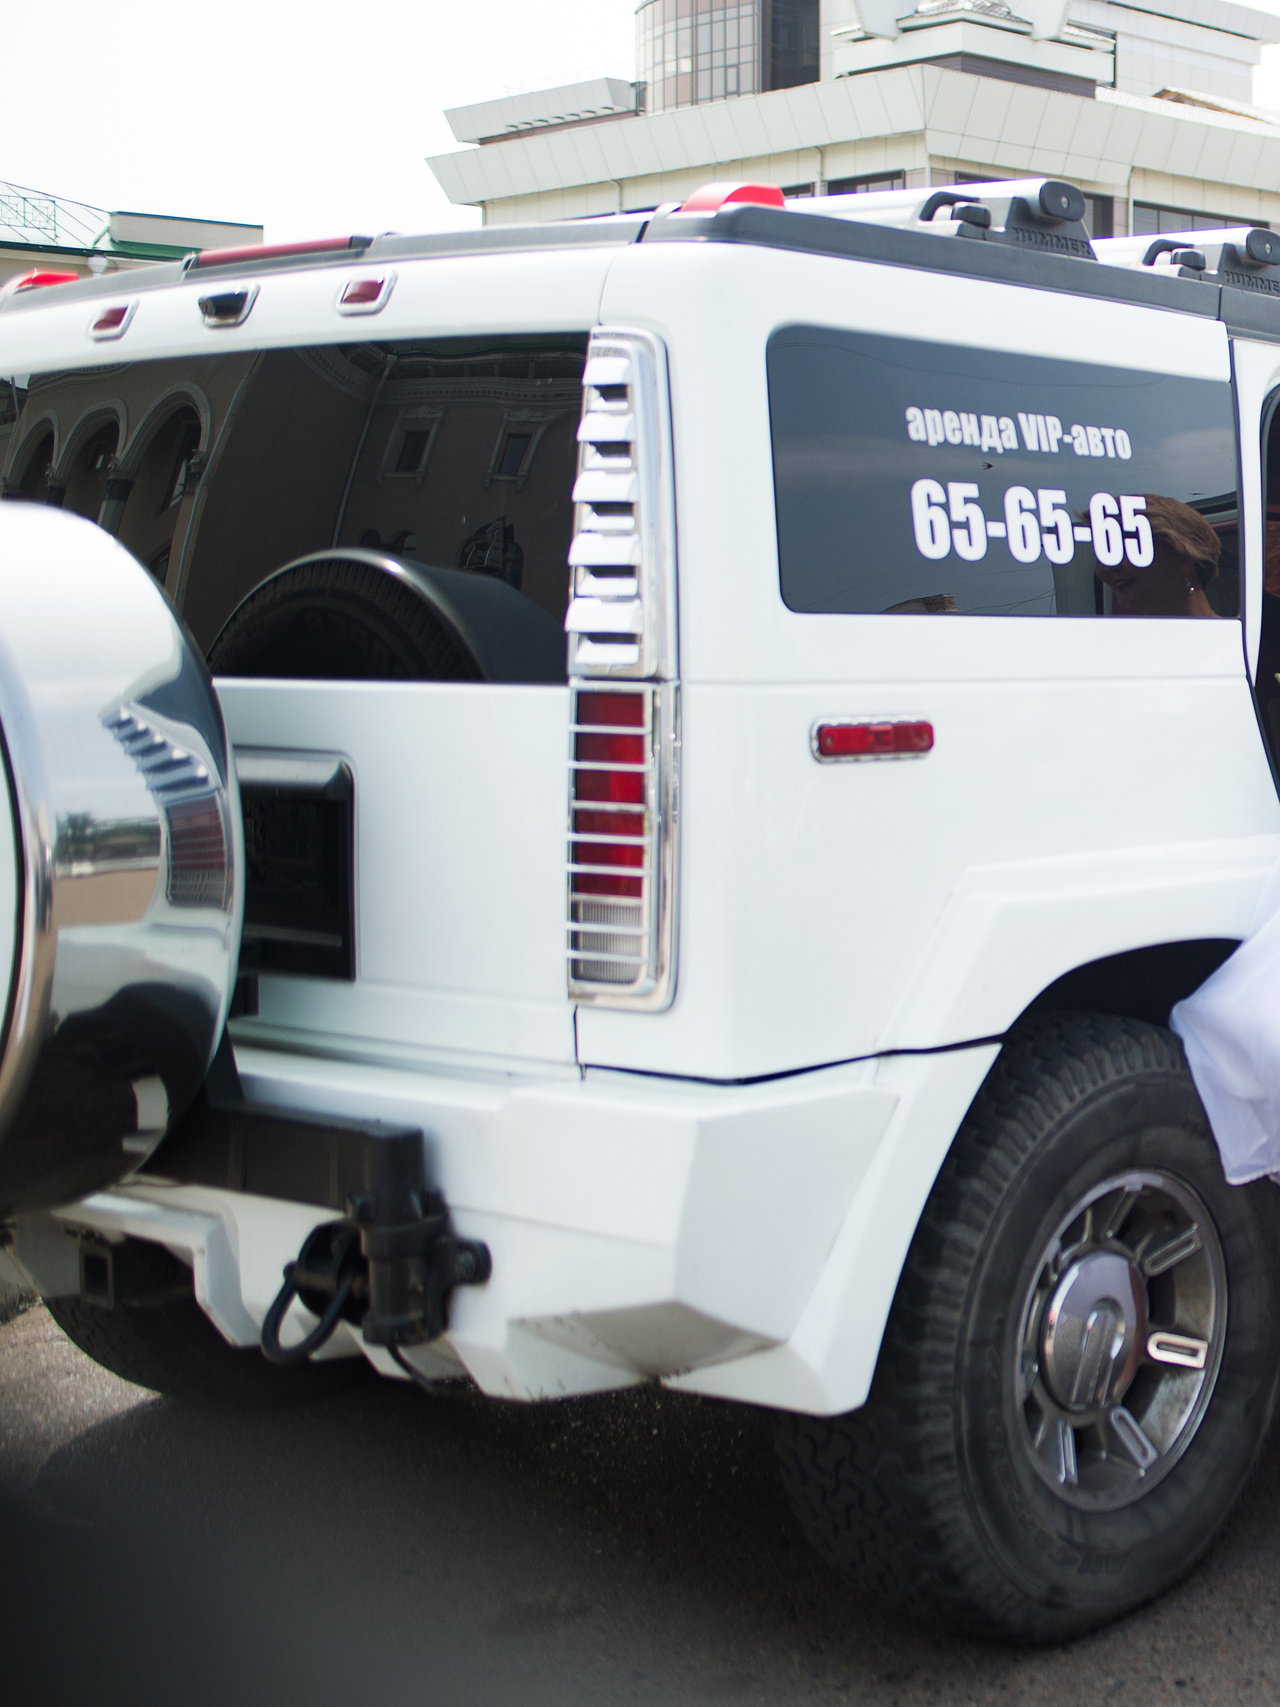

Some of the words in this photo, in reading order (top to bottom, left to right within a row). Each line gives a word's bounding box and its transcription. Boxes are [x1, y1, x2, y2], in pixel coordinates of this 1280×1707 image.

[1013, 227, 1092, 256] HUMMER
[906, 405, 1018, 454] аренда
[1018, 411, 1133, 461] VIP-авто
[910, 477, 1155, 569] 65-65-65
